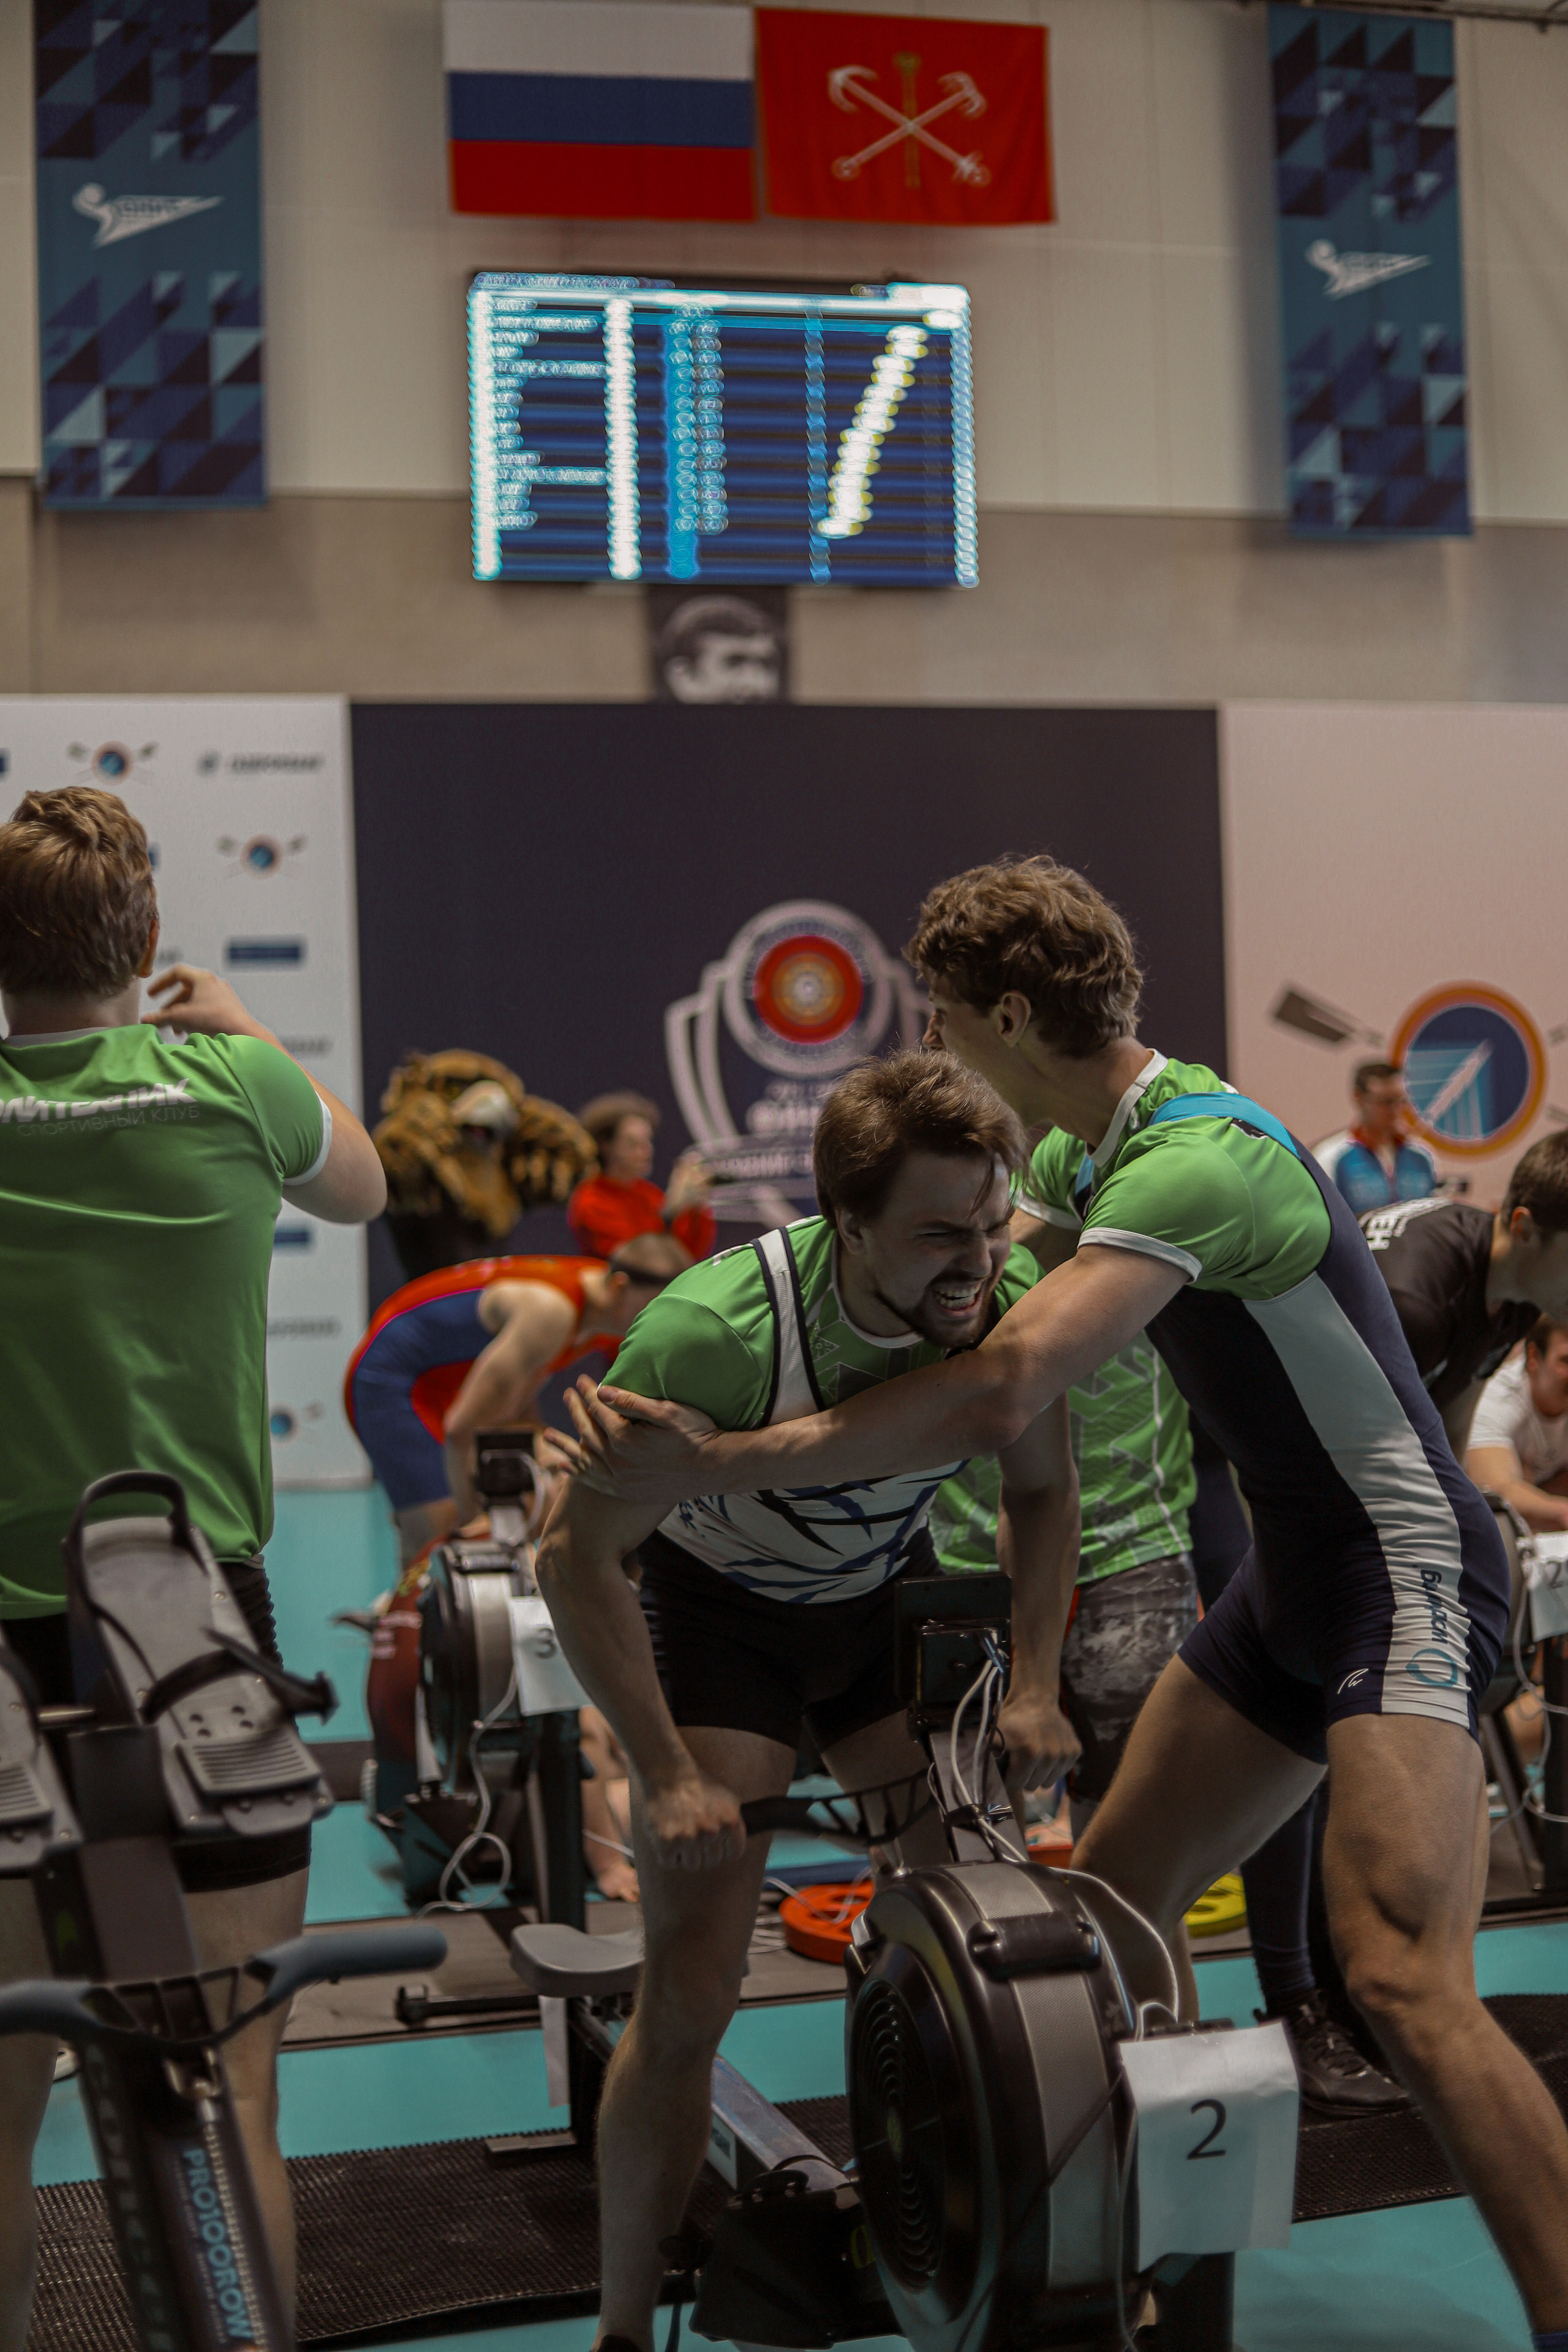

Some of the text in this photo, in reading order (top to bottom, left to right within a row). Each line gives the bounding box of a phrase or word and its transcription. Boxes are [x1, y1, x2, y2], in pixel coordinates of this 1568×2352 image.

[17, 1106, 200, 1136] СПОРТИВНЫЙ КЛУБ
[537, 1627, 557, 1659] 3
[1186, 2098, 1227, 2160] 2
